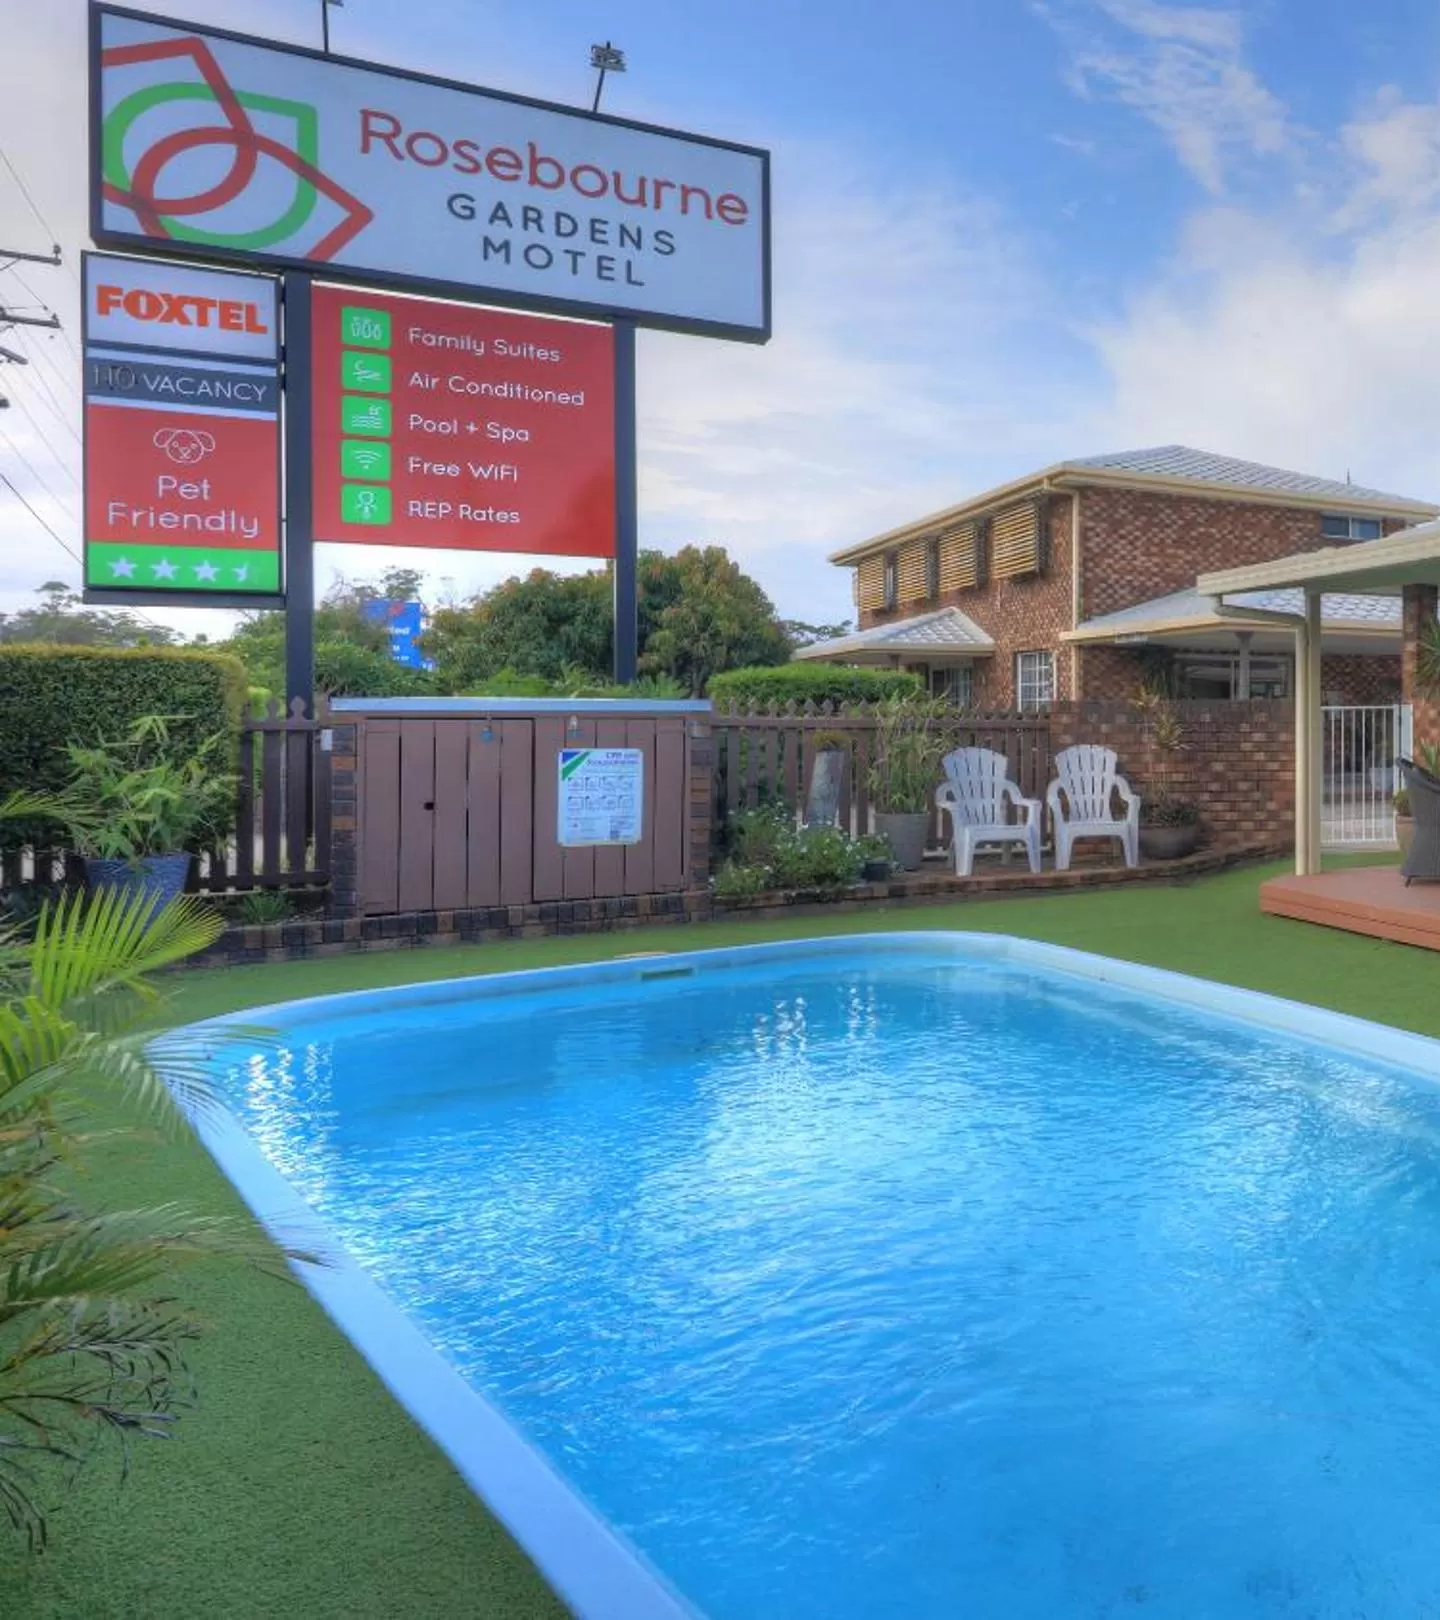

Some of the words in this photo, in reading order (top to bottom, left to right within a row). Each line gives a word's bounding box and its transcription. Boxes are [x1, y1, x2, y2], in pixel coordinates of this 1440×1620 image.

[360, 108, 749, 225] Rosebourne
[447, 193, 677, 256] GARDENS
[482, 235, 645, 286] MOTEL
[97, 285, 268, 334] FOXTEL
[409, 328, 486, 356] Family
[494, 339, 561, 362] Suites
[143, 373, 268, 402] VACANCY
[409, 372, 440, 390] Air
[449, 375, 585, 406] Conditioned
[409, 414, 458, 435] Pool
[466, 423, 479, 434] +
[487, 423, 530, 443] Spa
[408, 456, 461, 478] Free
[158, 475, 212, 502] Pet
[108, 502, 260, 539] Friendly
[409, 500, 452, 520] REP
[459, 504, 521, 523] Rates
